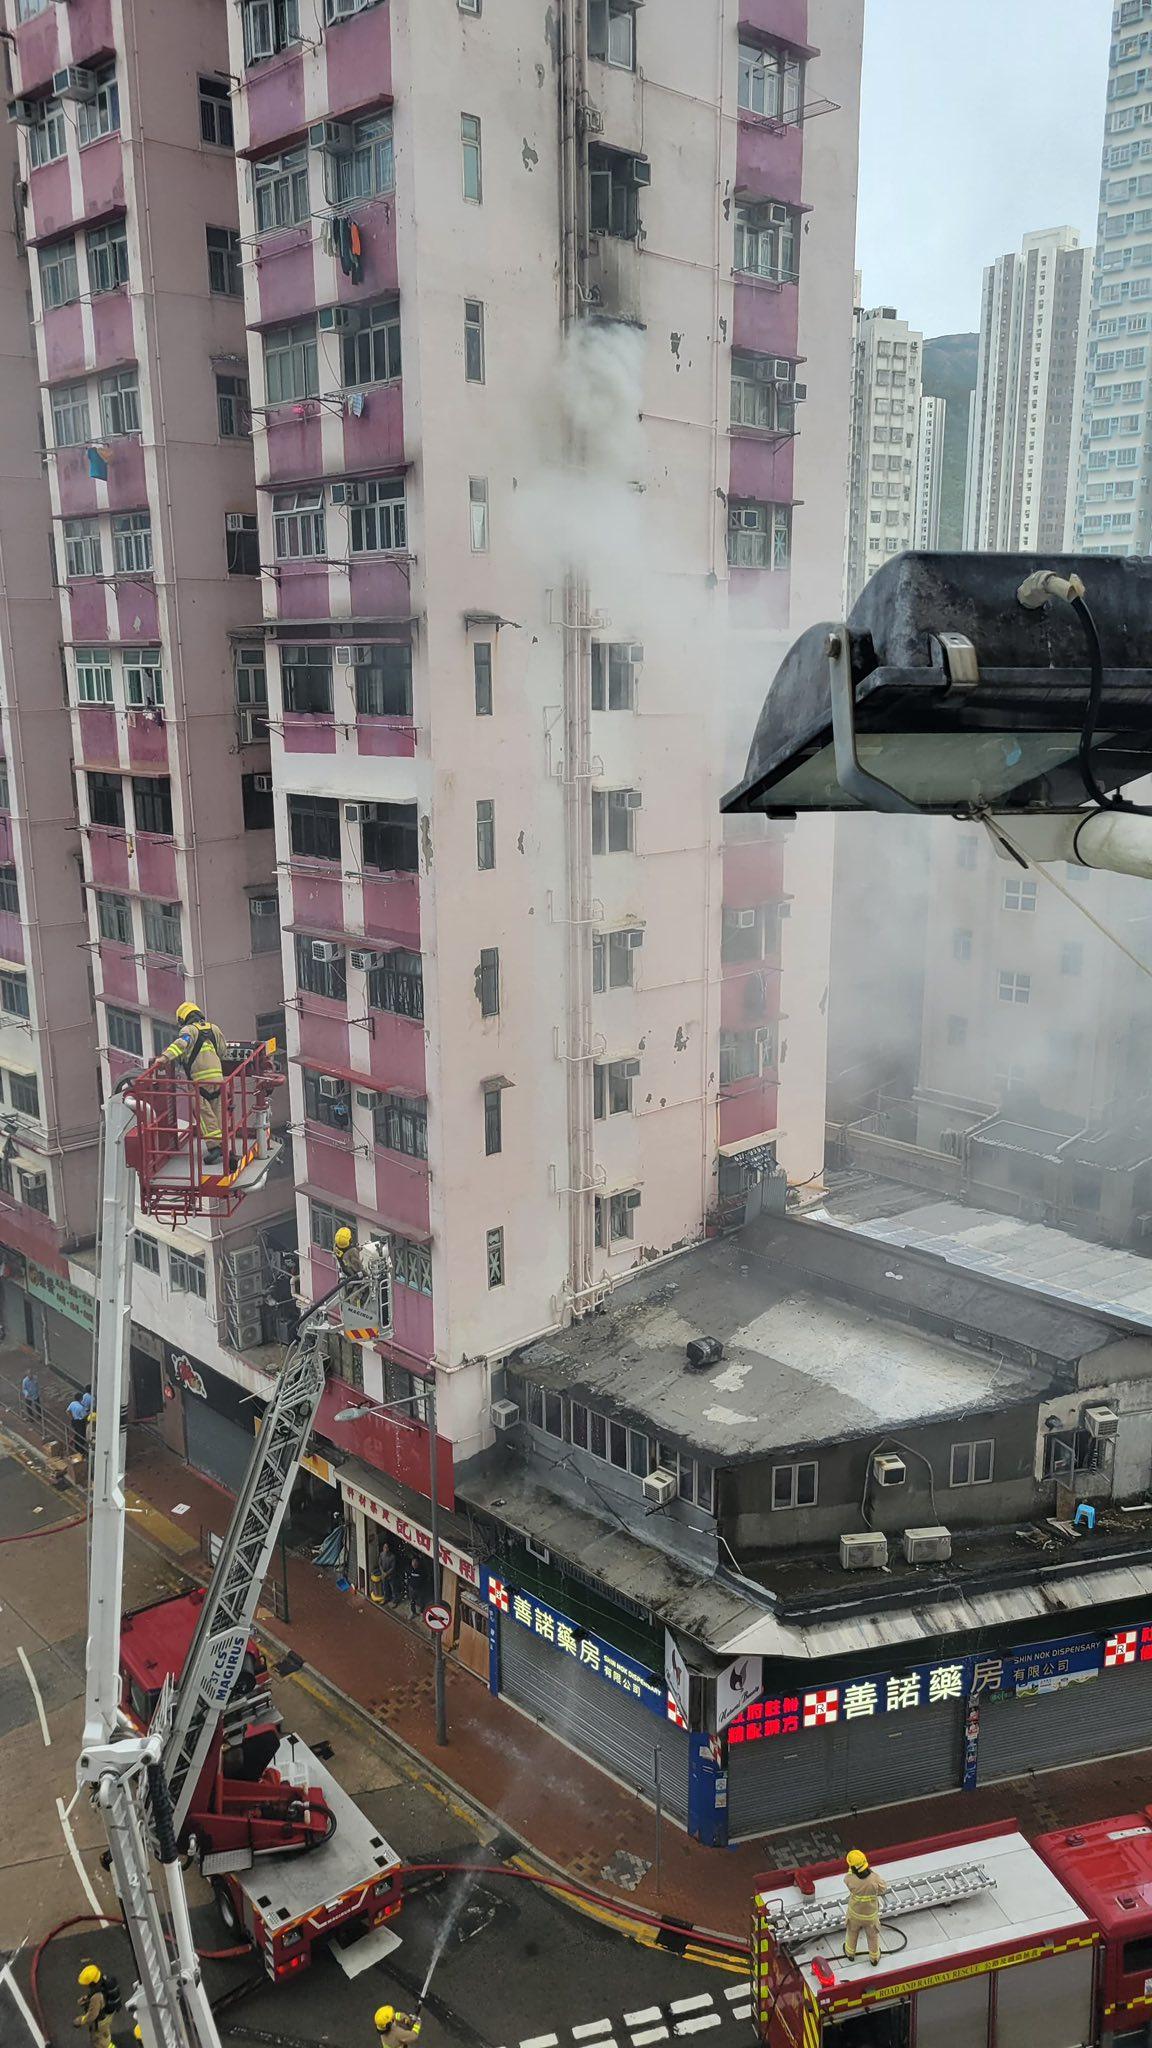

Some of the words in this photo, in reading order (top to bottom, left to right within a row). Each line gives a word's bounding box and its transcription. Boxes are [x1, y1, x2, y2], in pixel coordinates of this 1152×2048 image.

[513, 1594, 601, 1671] 善諾藥房
[209, 1671, 219, 1685] 37
[215, 1650, 227, 1668] CS
[216, 1637, 244, 1700] MAGIRUS
[604, 1655, 616, 1667] SHIN
[616, 1663, 628, 1675] NOK
[1014, 1654, 1033, 1664] SHIN
[1034, 1651, 1051, 1660] NOK
[1052, 1641, 1101, 1657] DISPENSARY
[604, 1665, 641, 1697] 有限公司
[1014, 1659, 1069, 1681] 有限公司
[842, 1658, 1004, 1719] 善諾藥房
[879, 1985, 900, 1998] ROAD
[900, 1981, 917, 1992] AND
[918, 1973, 950, 1988] RAILWAY
[952, 1965, 979, 1979] RESCUE
